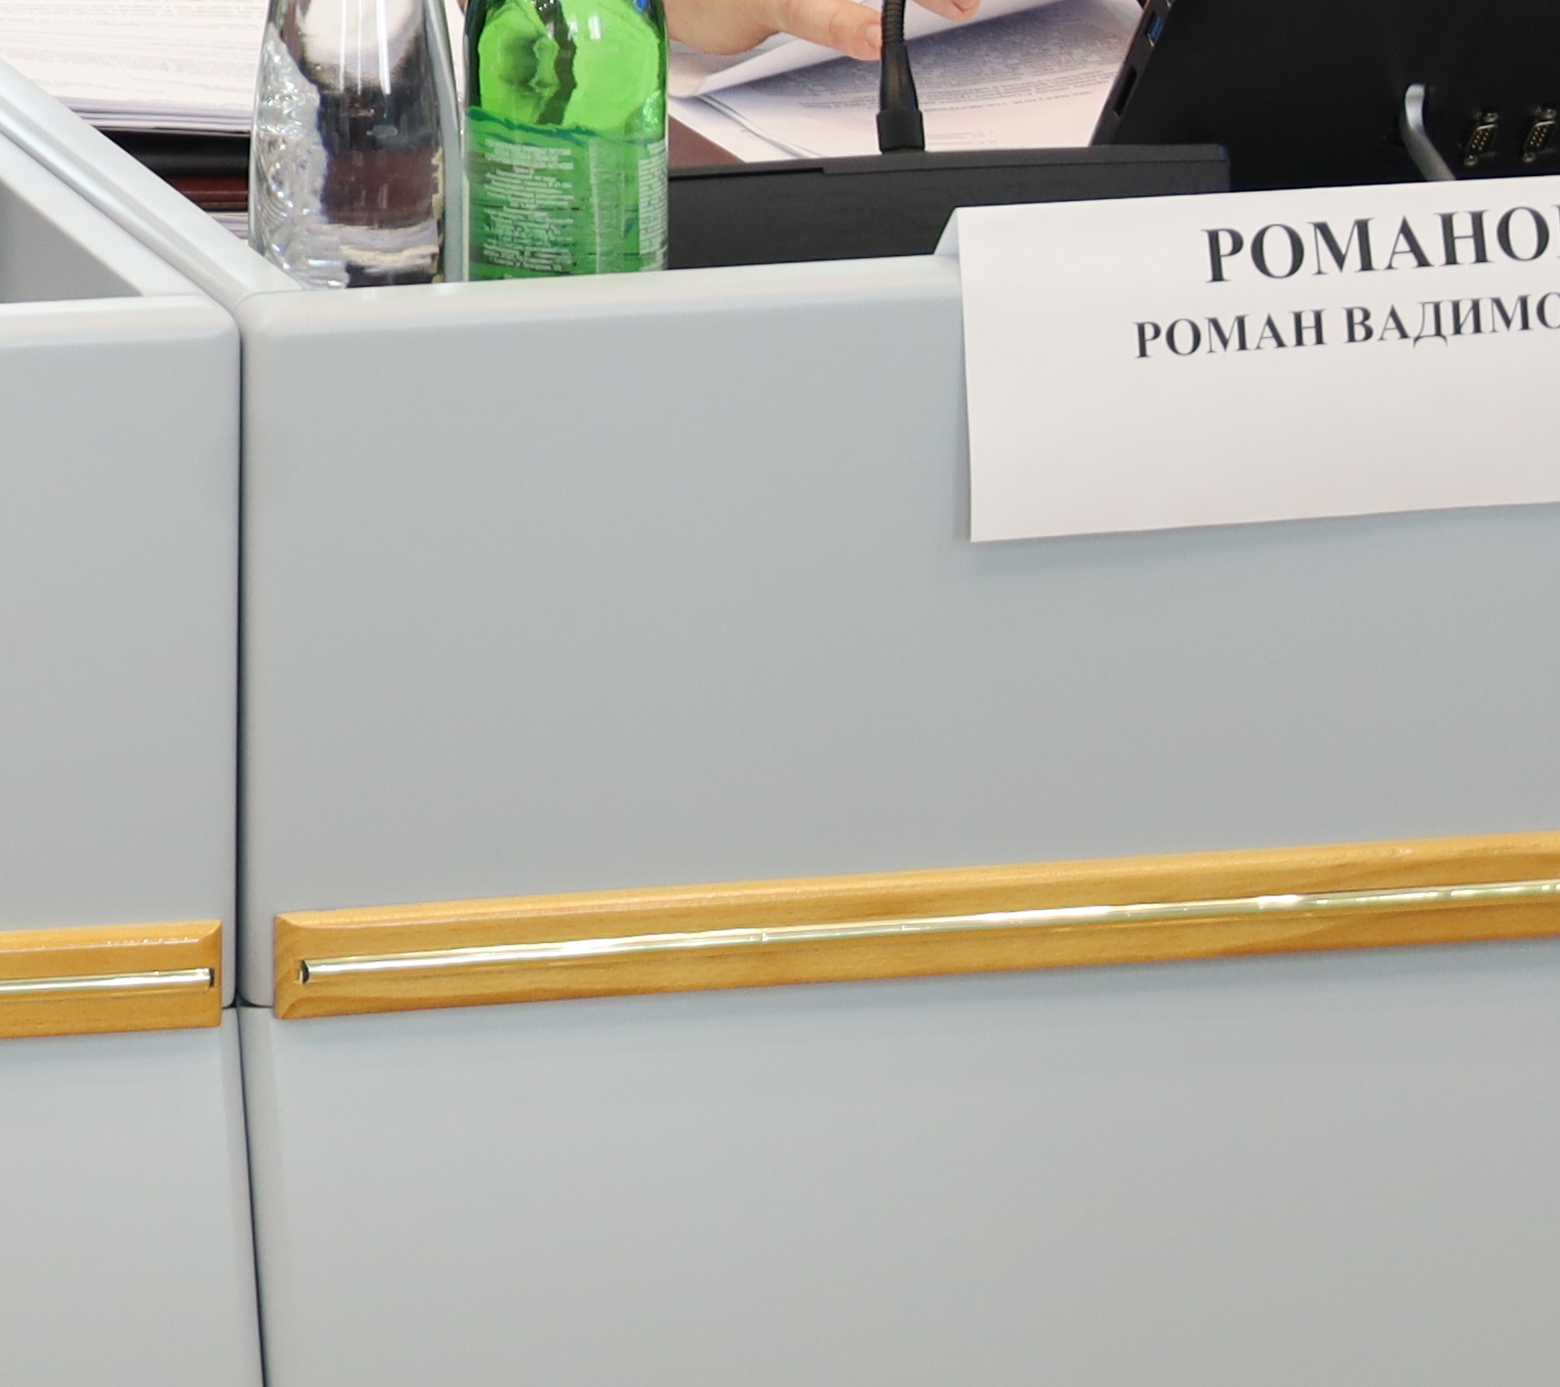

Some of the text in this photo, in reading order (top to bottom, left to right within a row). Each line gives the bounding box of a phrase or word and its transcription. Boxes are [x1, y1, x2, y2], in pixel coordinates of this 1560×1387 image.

[1202, 204, 1560, 284] РОМАНО
[1133, 291, 1560, 359] РОМАН ВАДИМО
